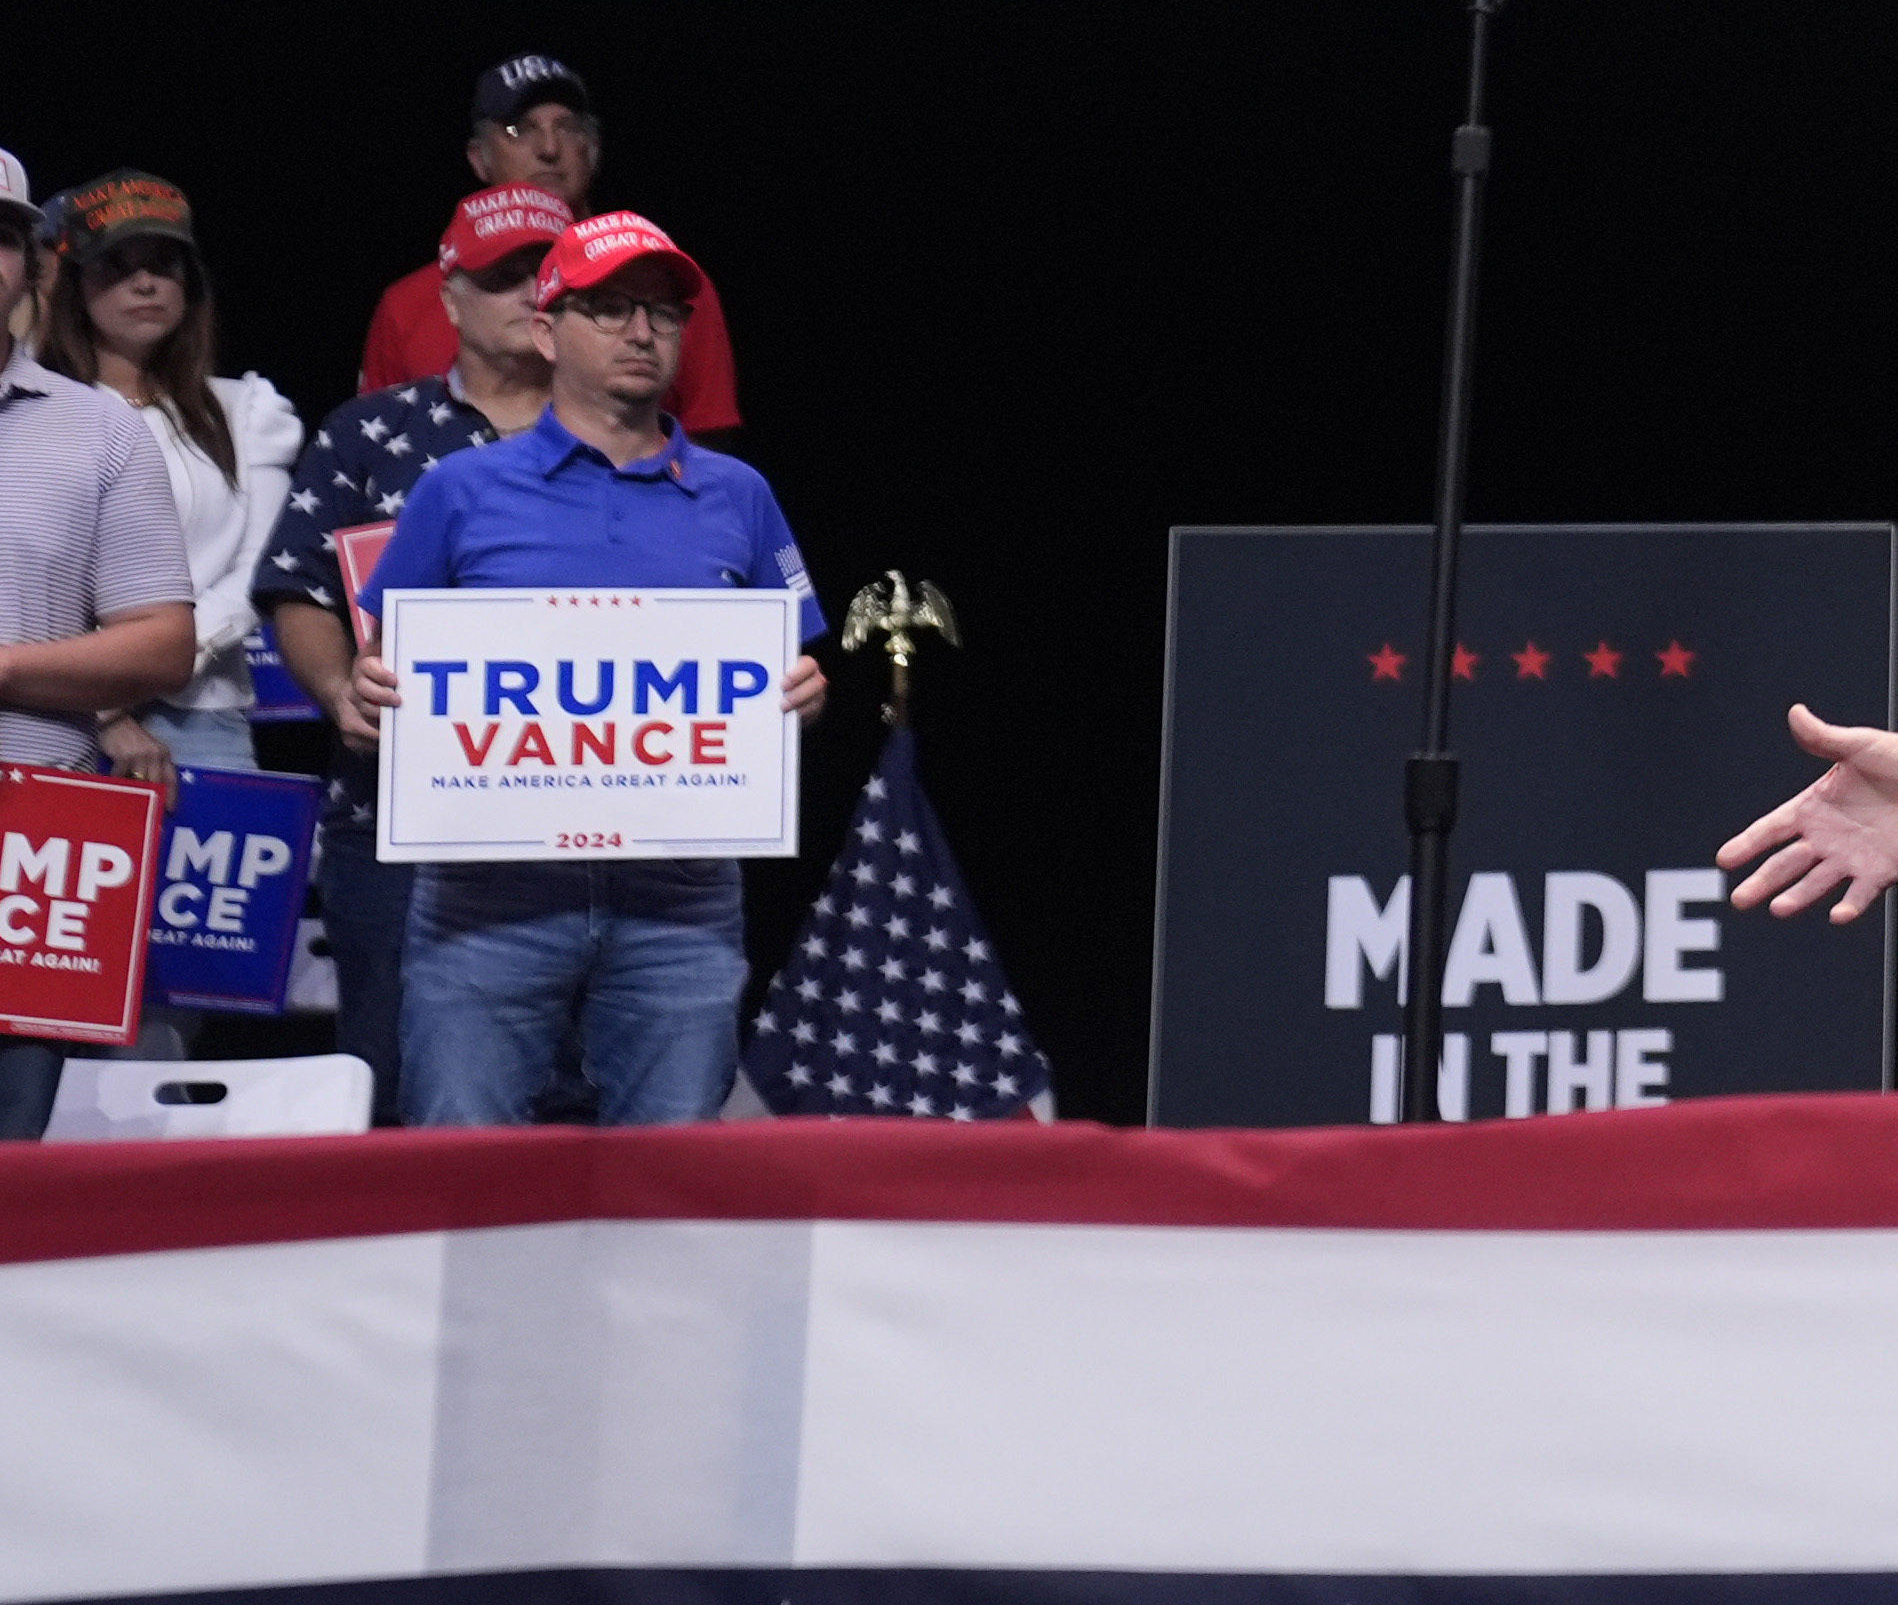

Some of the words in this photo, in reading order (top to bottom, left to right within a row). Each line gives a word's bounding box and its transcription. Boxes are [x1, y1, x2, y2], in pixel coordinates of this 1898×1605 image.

[463, 189, 508, 218] MAKE
[473, 209, 524, 241] GREAT
[573, 213, 620, 240] MAKE
[584, 231, 639, 263] GREAT
[245, 651, 280, 667] AIN!
[412, 658, 770, 717] TRUMP
[452, 720, 729, 767] VANCE
[431, 774, 490, 790] MAKE
[498, 773, 594, 789] AMERICA
[601, 772, 668, 788] GREAT
[675, 772, 748, 788] AGAIN!
[555, 832, 624, 849] 2024
[147, 928, 188, 946] EAT
[189, 932, 257, 953] AGAIN!
[1323, 866, 1727, 1009] MADE
[29, 951, 102, 974] AGAIN!
[1490, 1026, 1674, 1120] THE
